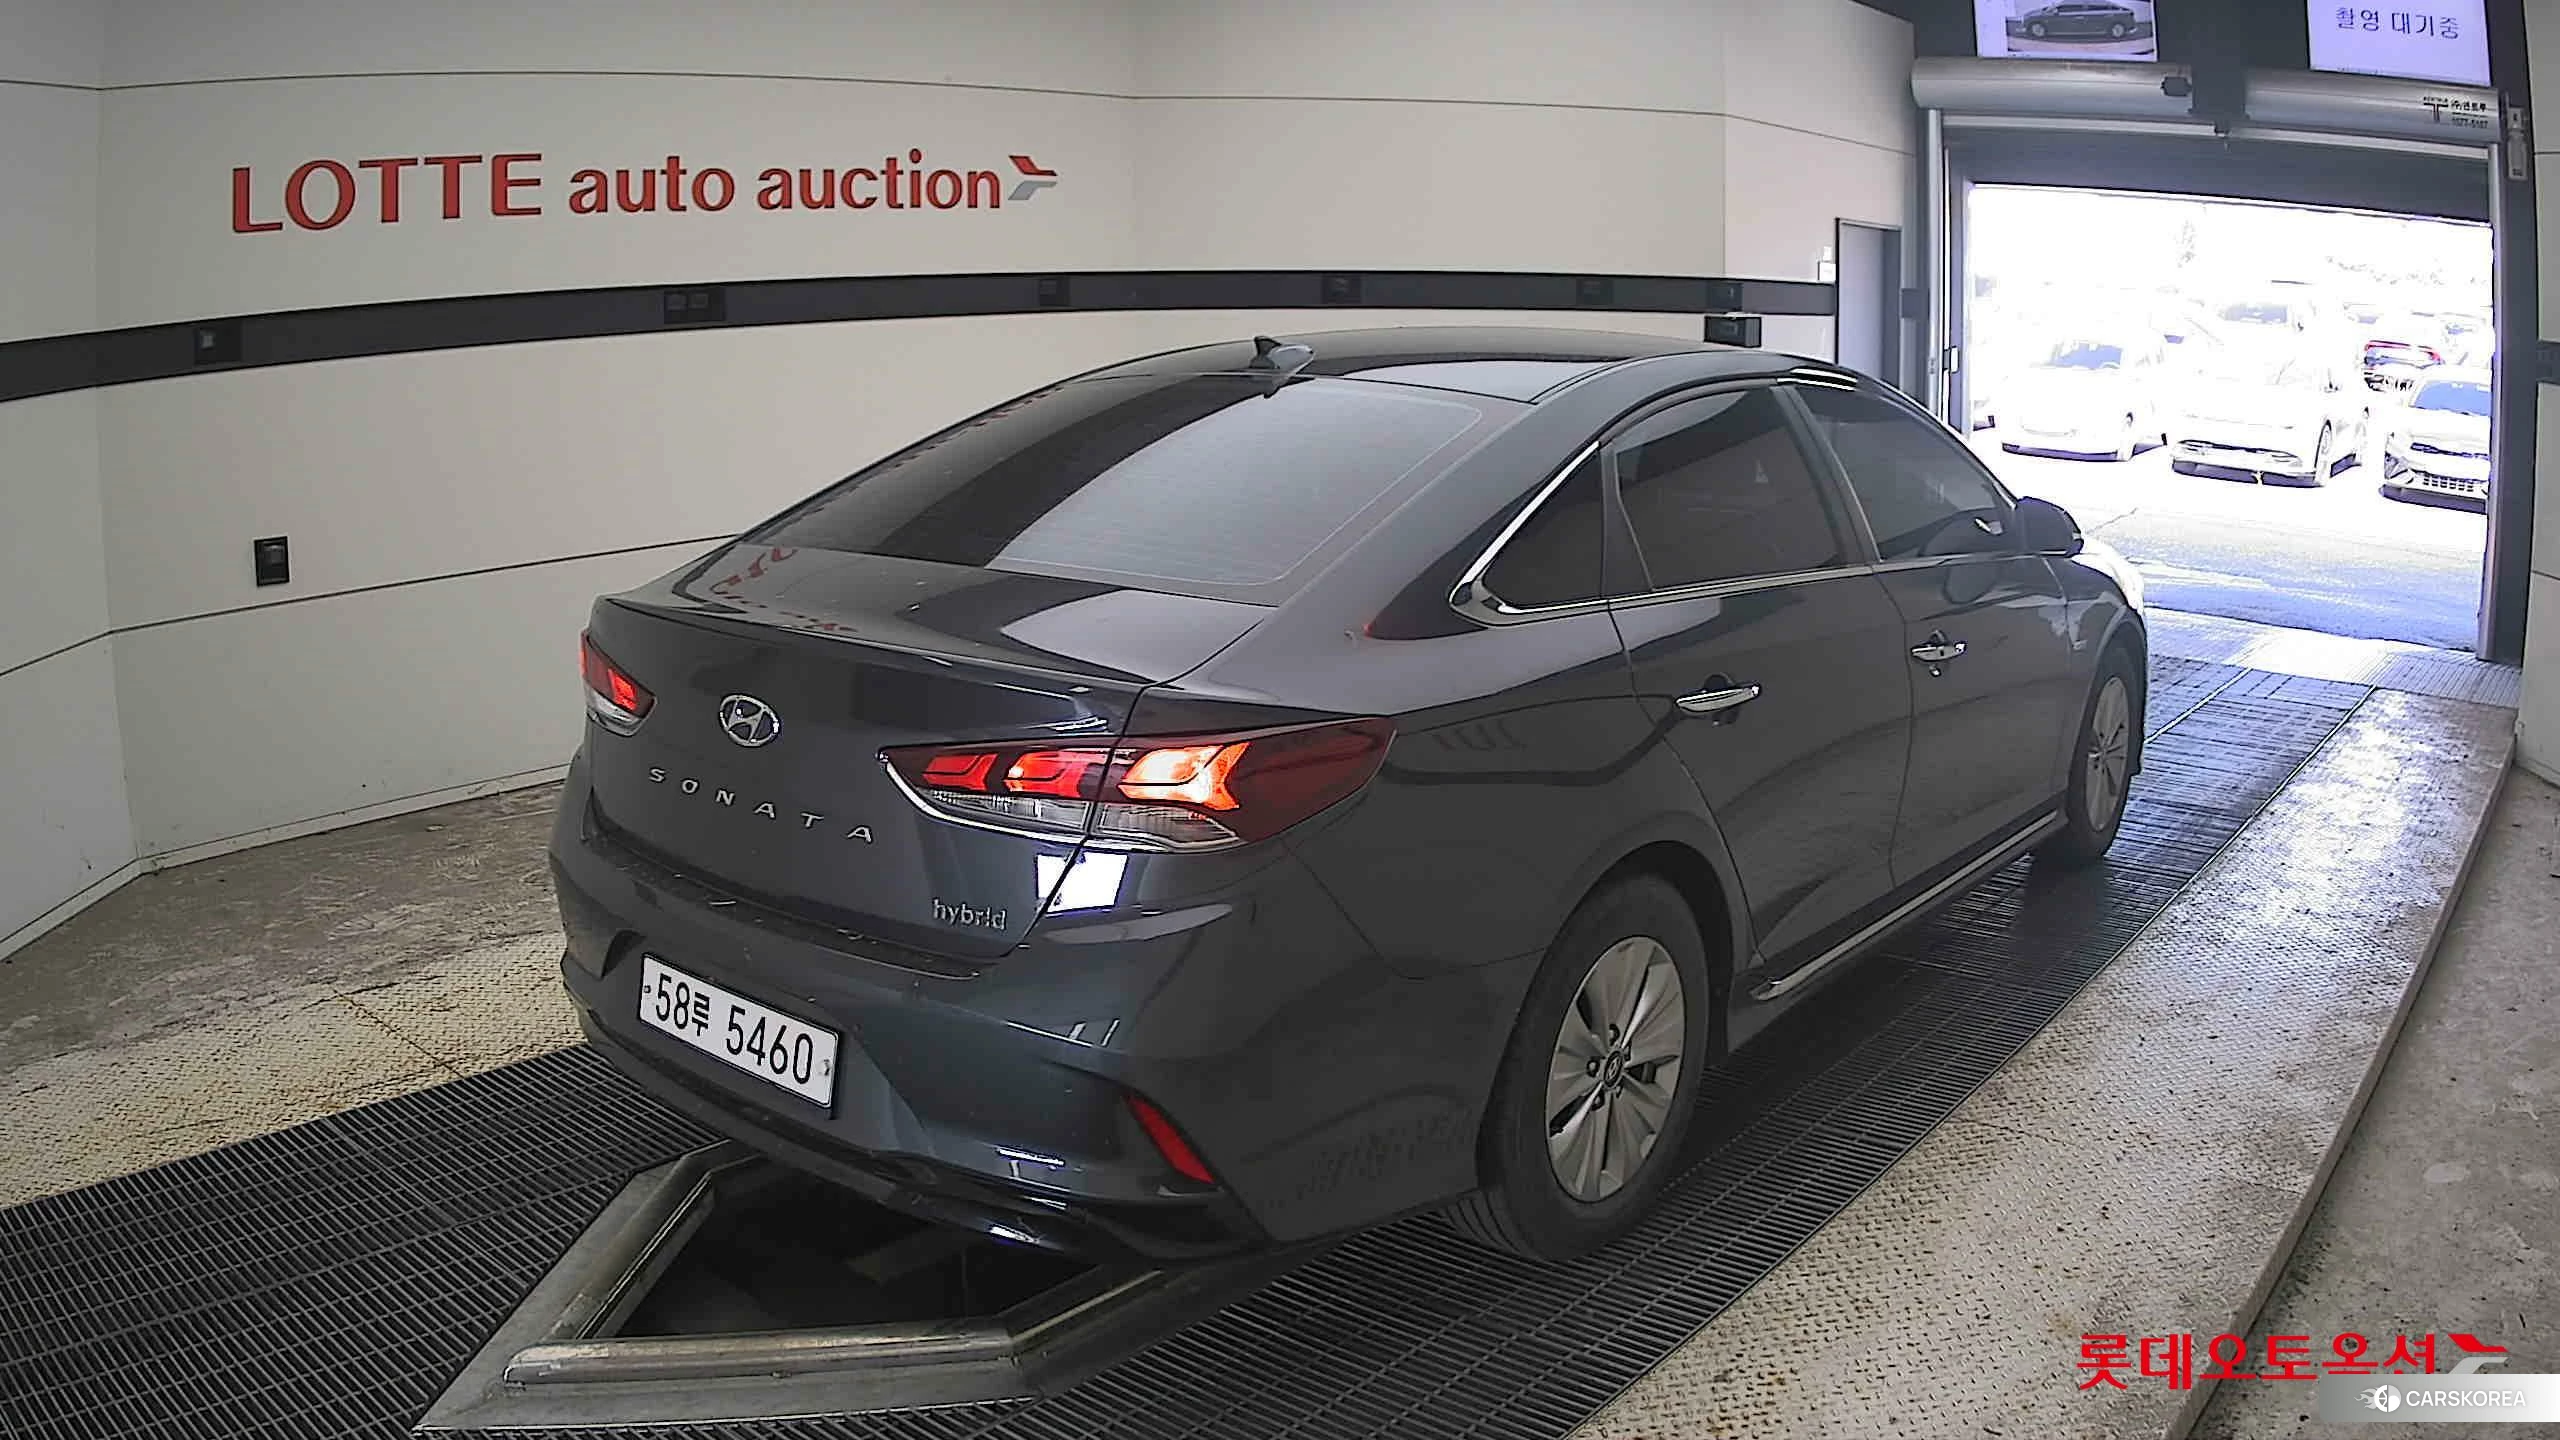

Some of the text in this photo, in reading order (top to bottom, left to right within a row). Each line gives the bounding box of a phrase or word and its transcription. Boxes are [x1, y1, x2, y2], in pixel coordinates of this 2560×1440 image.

[2336, 7, 2459, 39] 촬영 대기중
[232, 148, 1000, 233] LOTTE auto auction
[649, 768, 872, 843] SONATA
[933, 898, 1005, 930] hybrid
[656, 973, 813, 1084] 58루 5460
